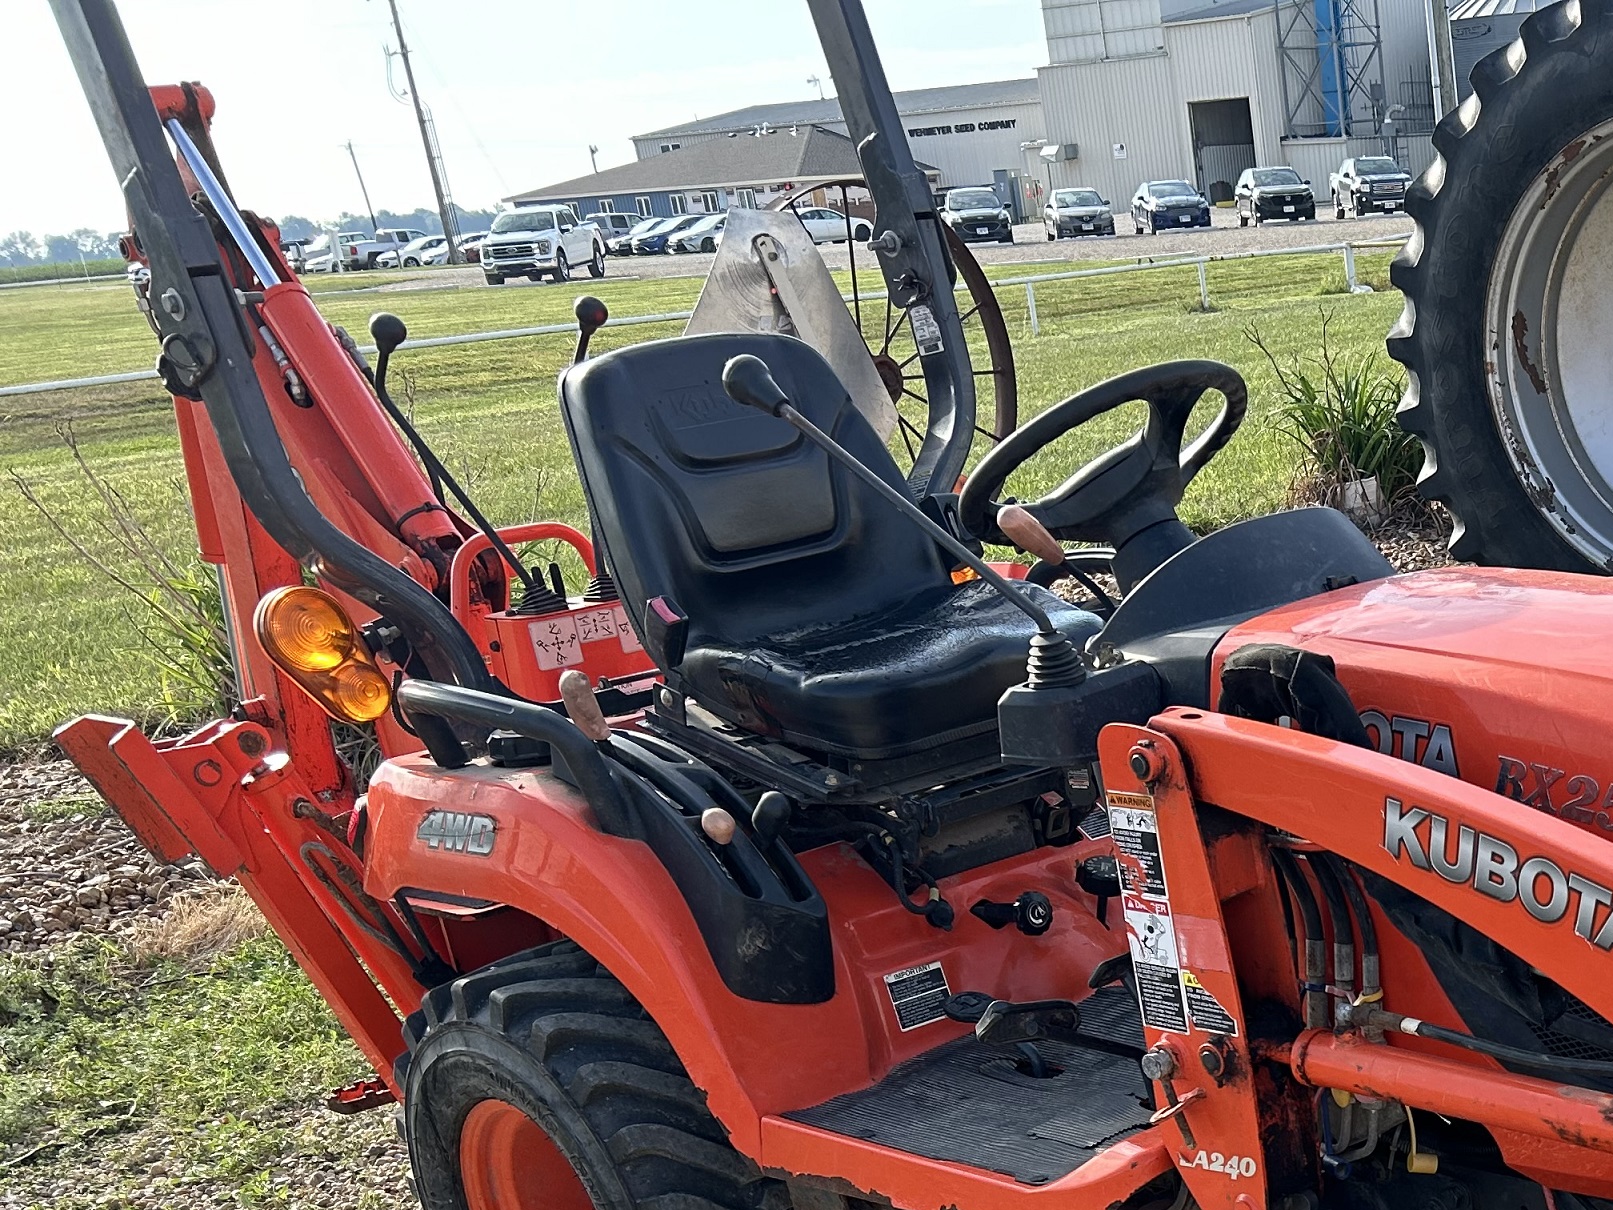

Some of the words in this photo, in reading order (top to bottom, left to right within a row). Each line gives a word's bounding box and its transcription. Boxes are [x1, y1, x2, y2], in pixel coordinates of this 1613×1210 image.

[954, 123, 976, 134] SEED
[978, 119, 1017, 131] COMPANY
[1357, 709, 1461, 779] OTA
[1115, 796, 1151, 808] WARNING
[417, 808, 496, 857] 4WD
[893, 964, 931, 980] IMPORTANT
